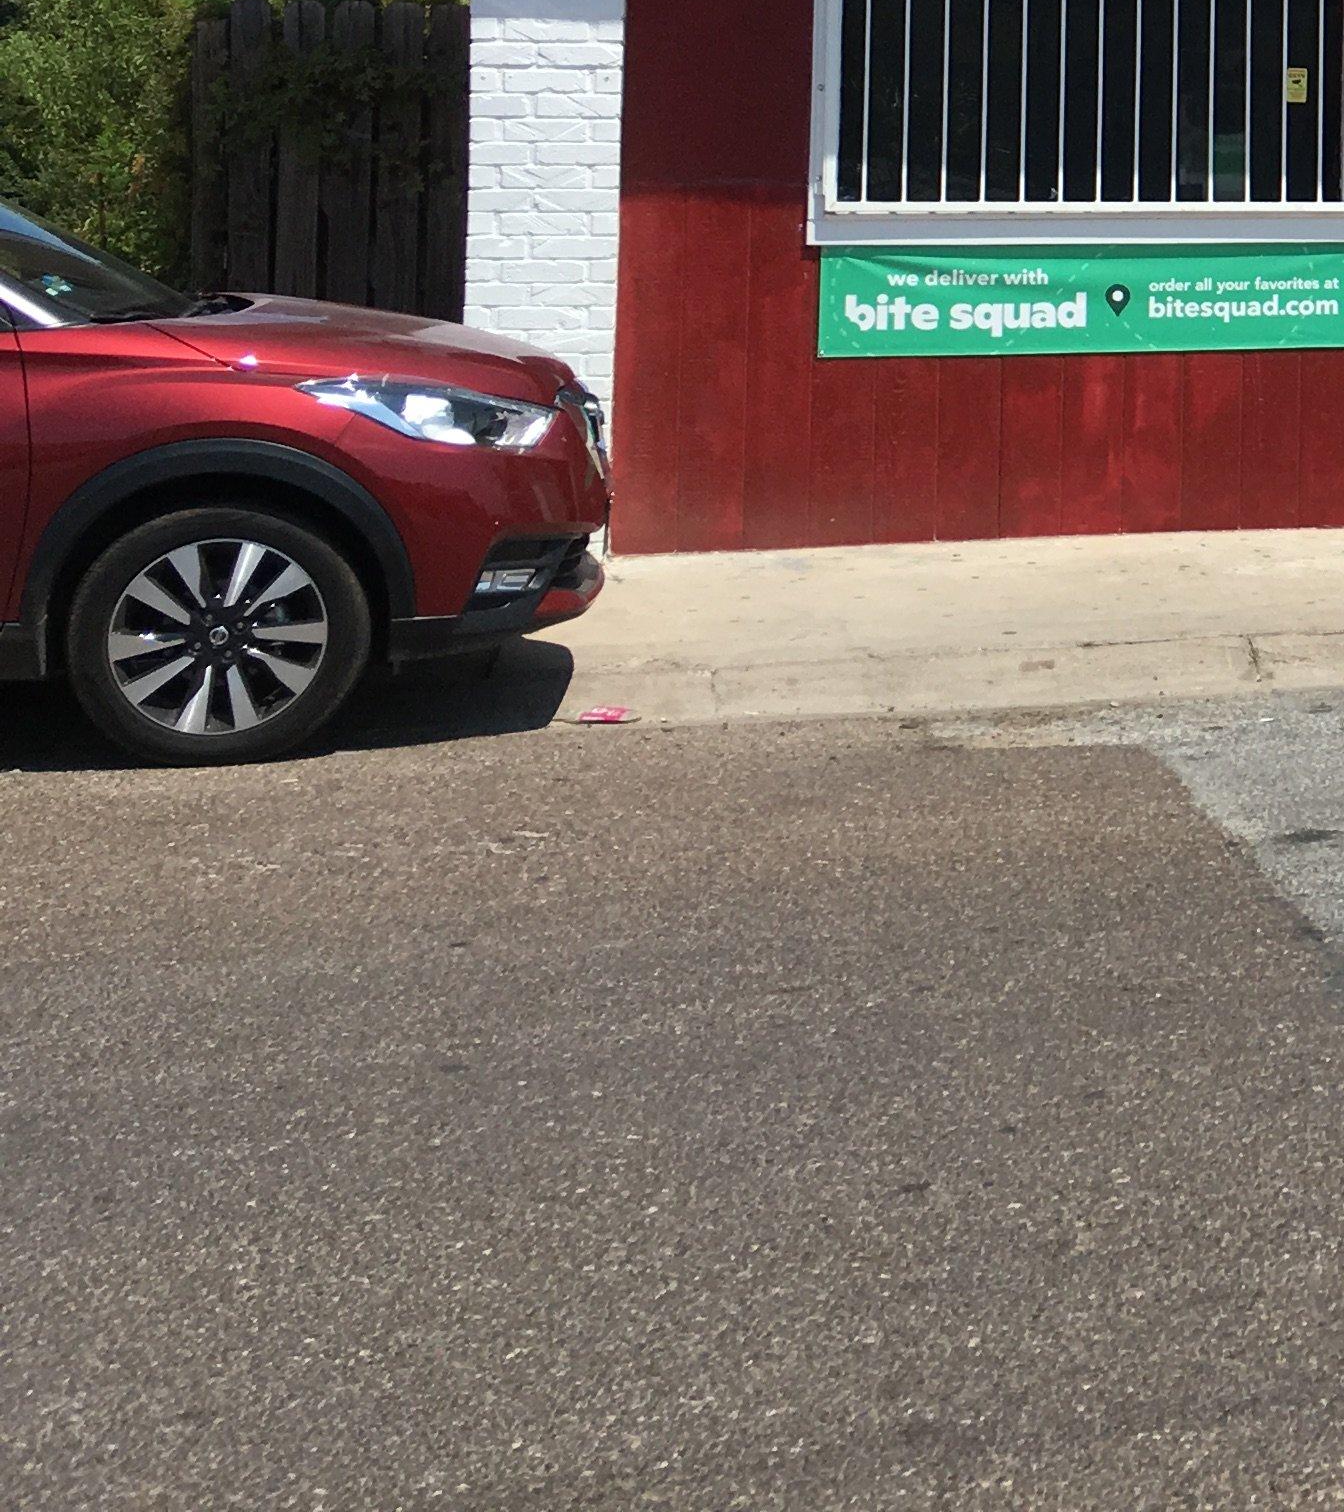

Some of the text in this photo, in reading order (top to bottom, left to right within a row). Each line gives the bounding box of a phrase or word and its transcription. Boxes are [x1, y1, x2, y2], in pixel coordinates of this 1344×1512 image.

[887, 268, 1048, 287] we deliver with
[1148, 276, 1340, 295] order all your favorites at
[844, 291, 1088, 338] bite squad
[1148, 294, 1339, 323] bitesquad.com
